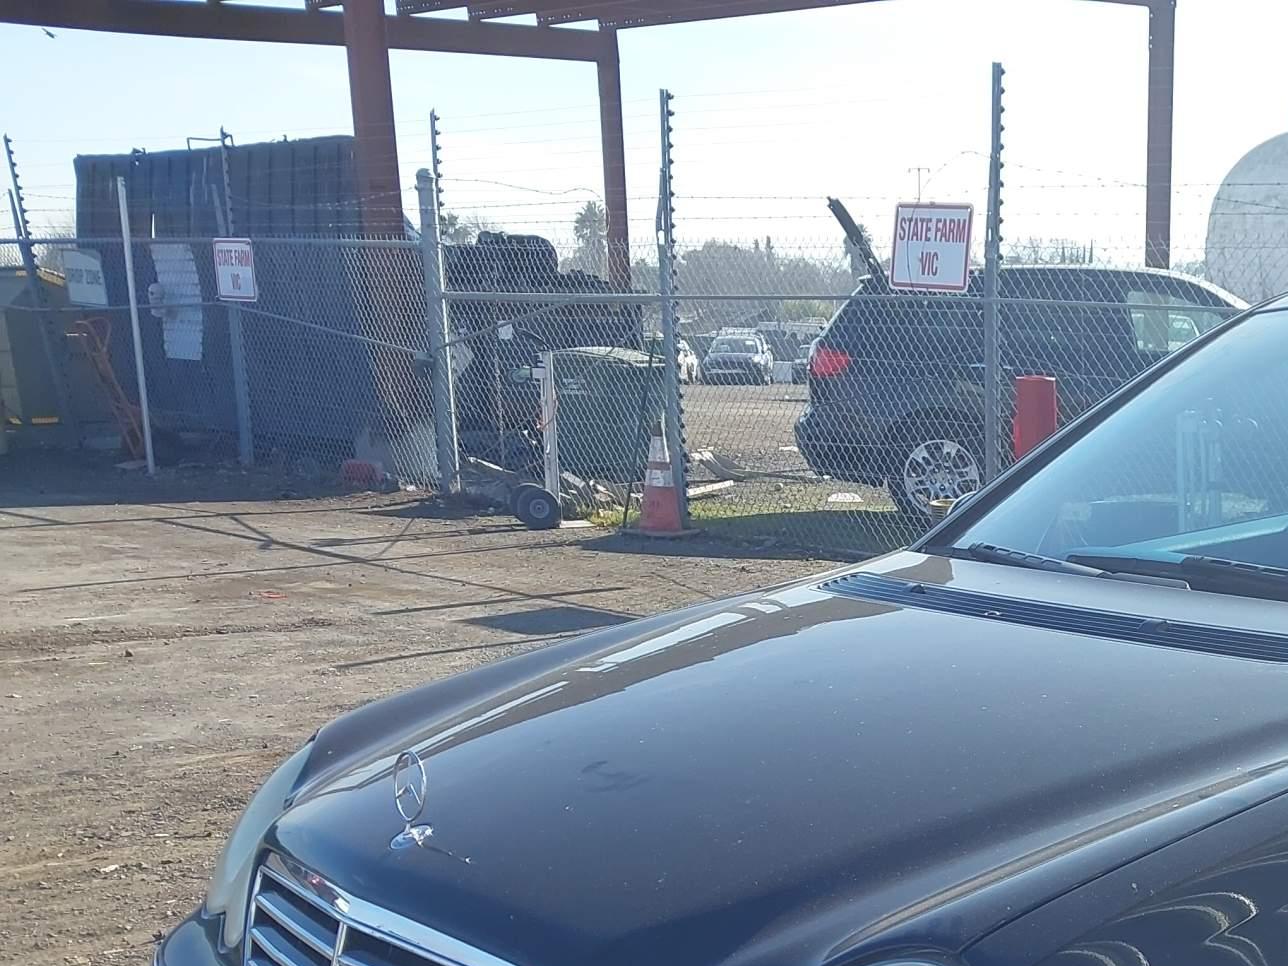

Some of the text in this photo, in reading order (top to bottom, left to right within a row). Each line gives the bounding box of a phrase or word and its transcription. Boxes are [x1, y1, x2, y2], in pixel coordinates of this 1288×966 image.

[898, 217, 967, 243] STATE FARM
[217, 249, 251, 267] STATE FARM
[920, 251, 939, 276] VIC
